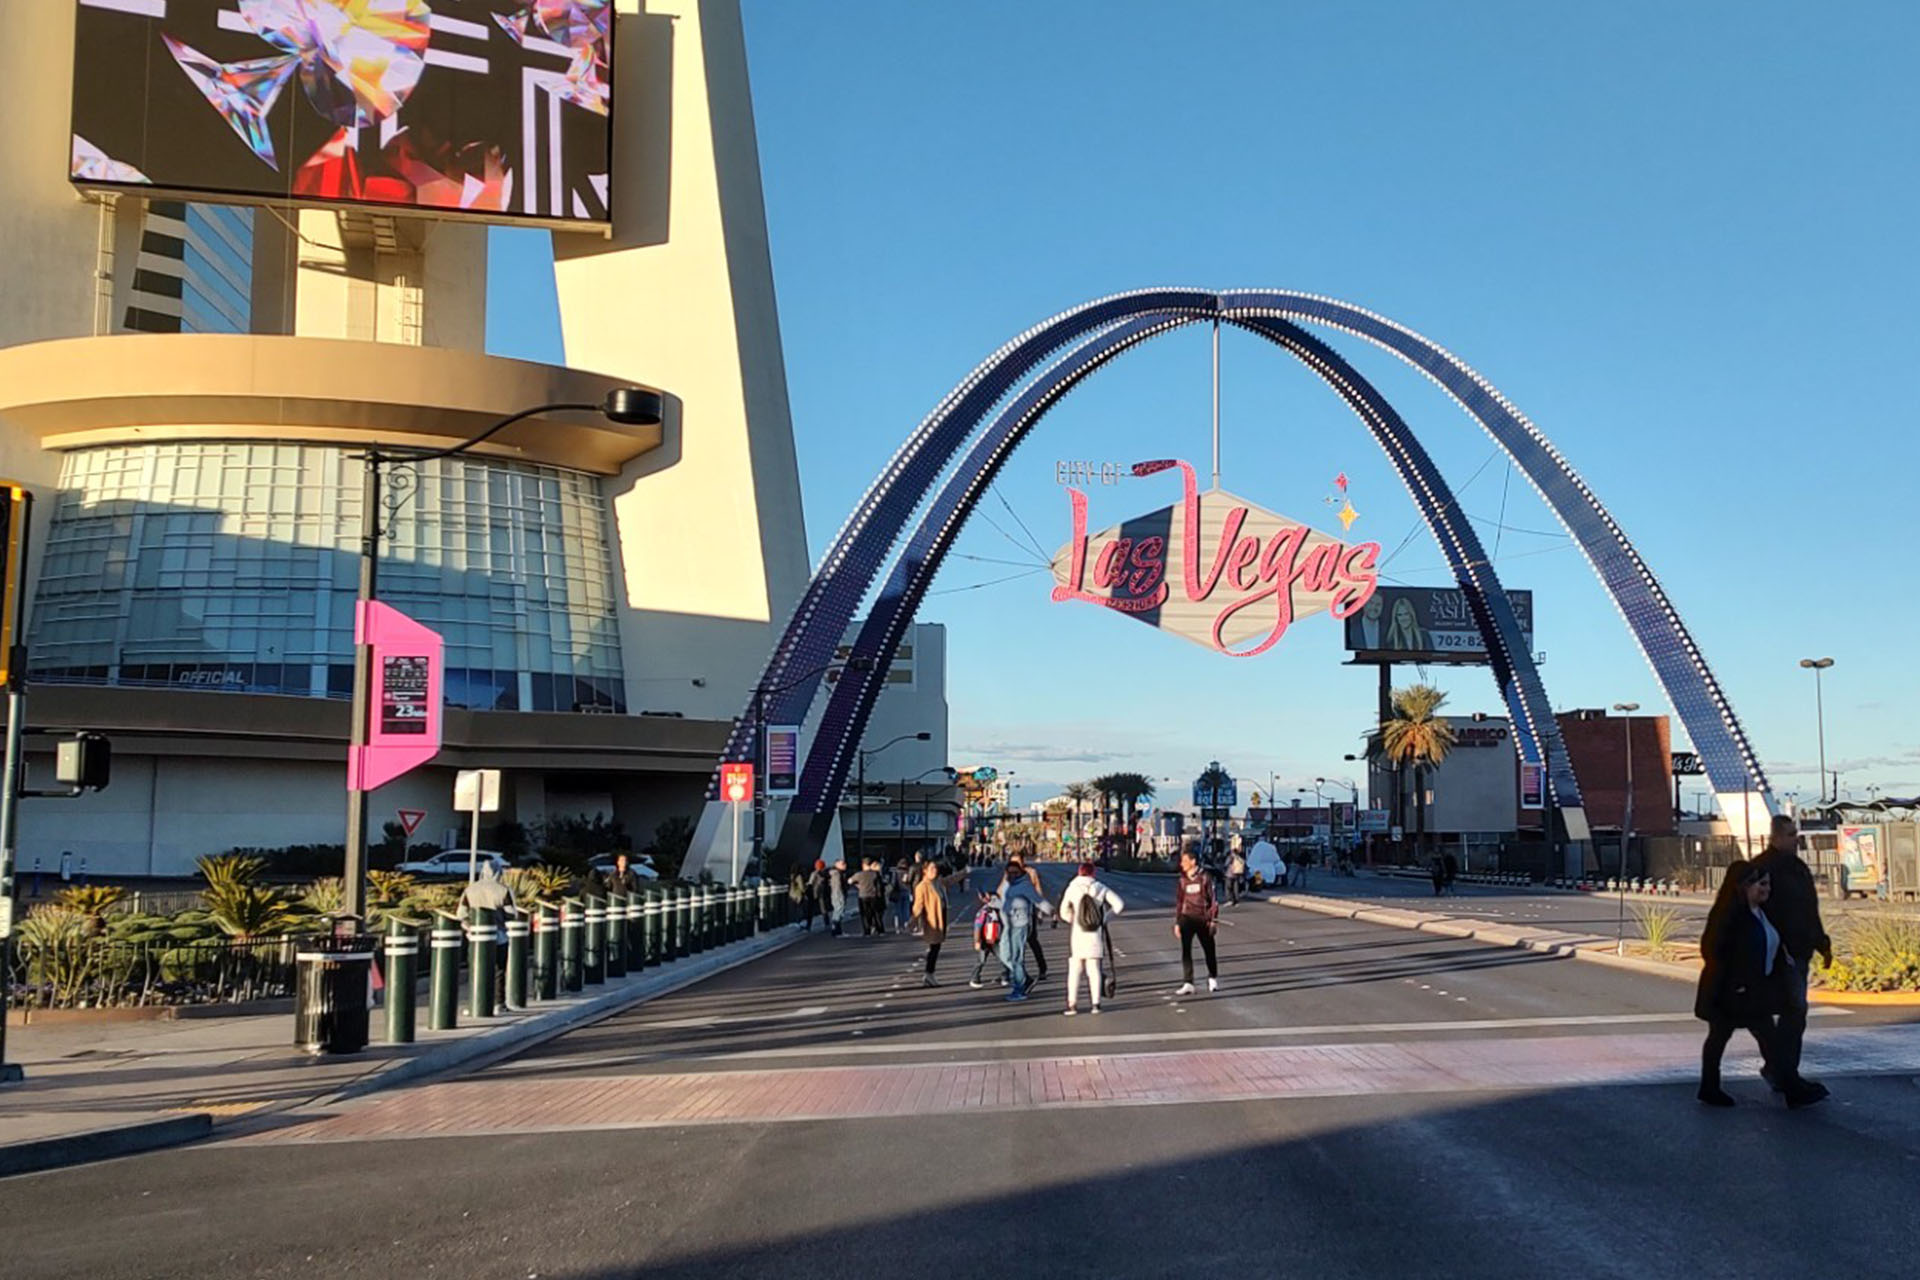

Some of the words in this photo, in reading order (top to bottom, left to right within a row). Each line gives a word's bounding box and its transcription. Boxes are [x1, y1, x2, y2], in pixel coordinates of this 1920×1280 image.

[1056, 460, 1094, 485] CITY
[1101, 461, 1122, 486] OF
[1052, 487, 1169, 613] Las
[1132, 459, 1381, 657] Vegas
